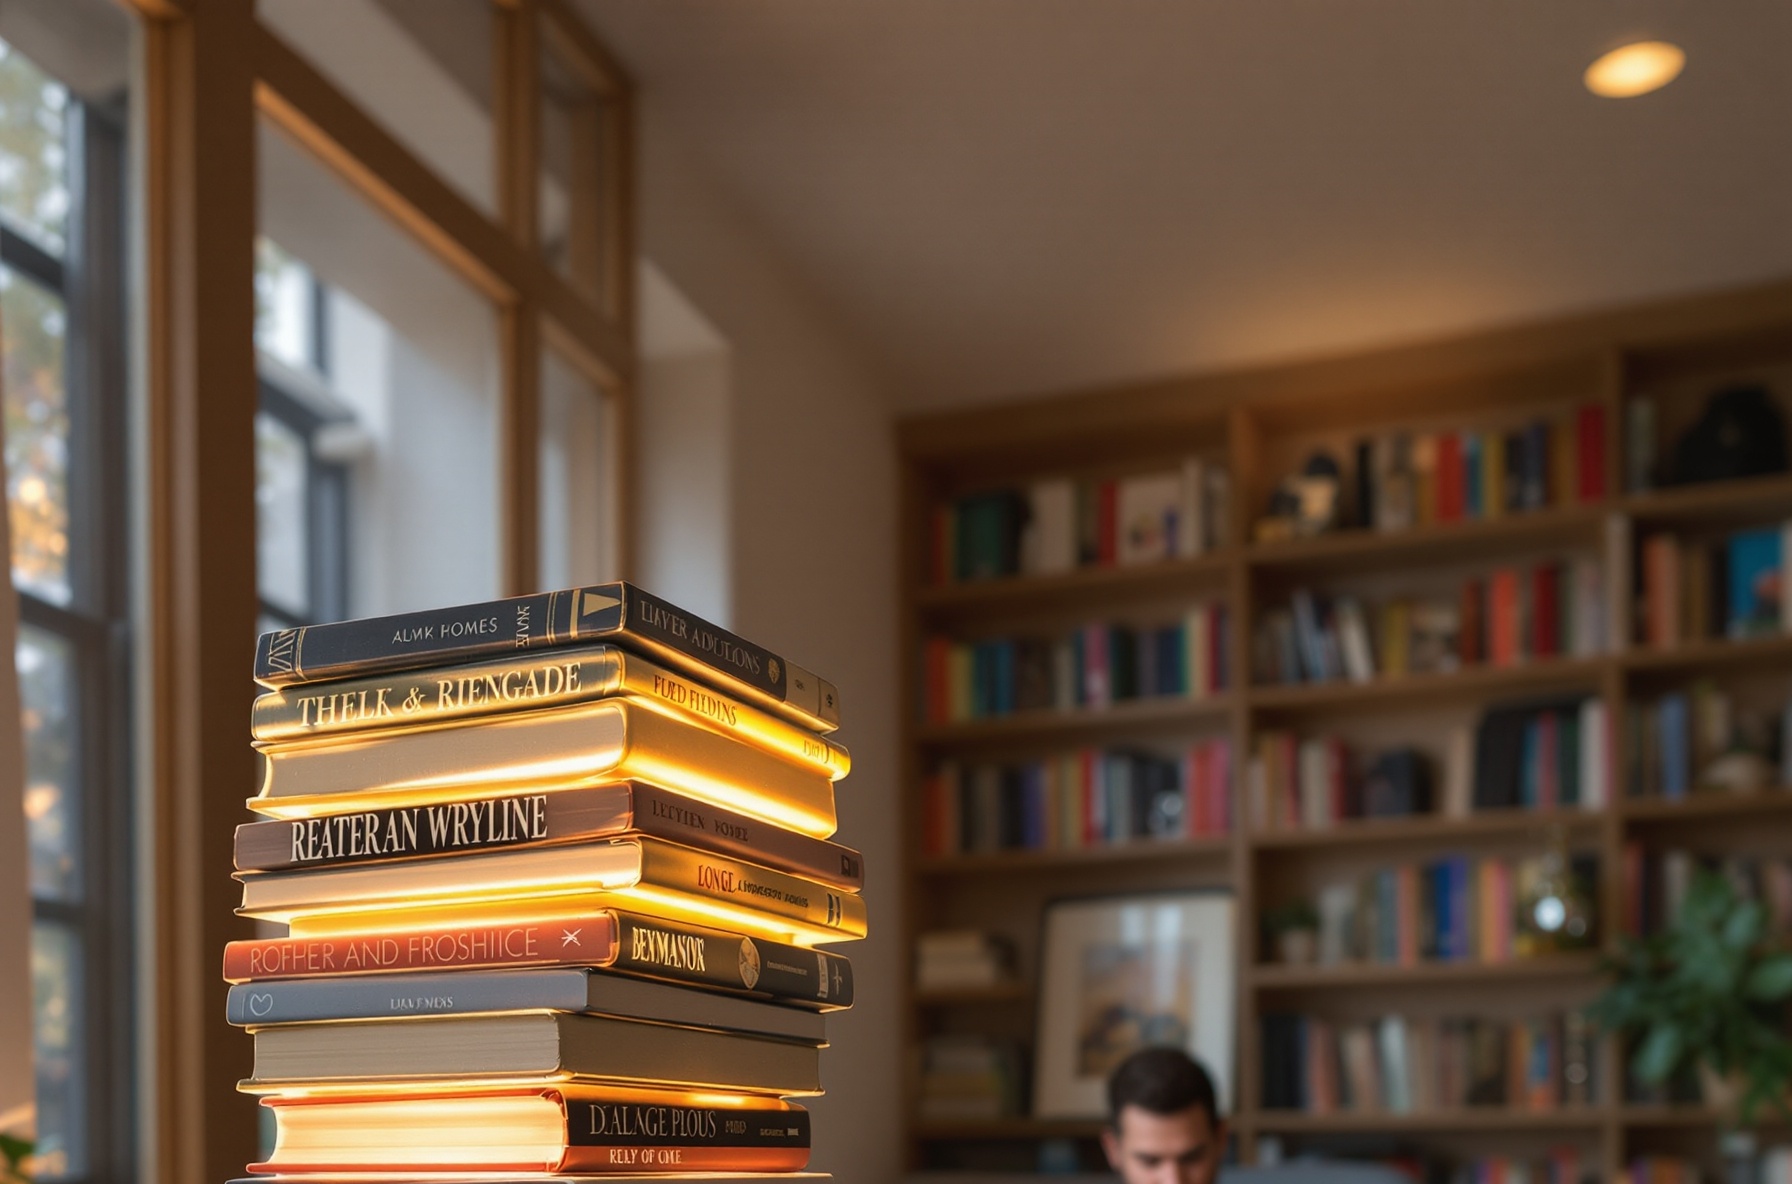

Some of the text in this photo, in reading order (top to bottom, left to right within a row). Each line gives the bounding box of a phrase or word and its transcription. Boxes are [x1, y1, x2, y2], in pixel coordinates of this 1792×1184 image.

[440, 616, 499, 639] HOMES
[296, 661, 583, 728] THELK & RIENGADE
[427, 794, 549, 849] WRYLINE
[250, 942, 336, 974] ROFHER
[343, 938, 400, 969] AND
